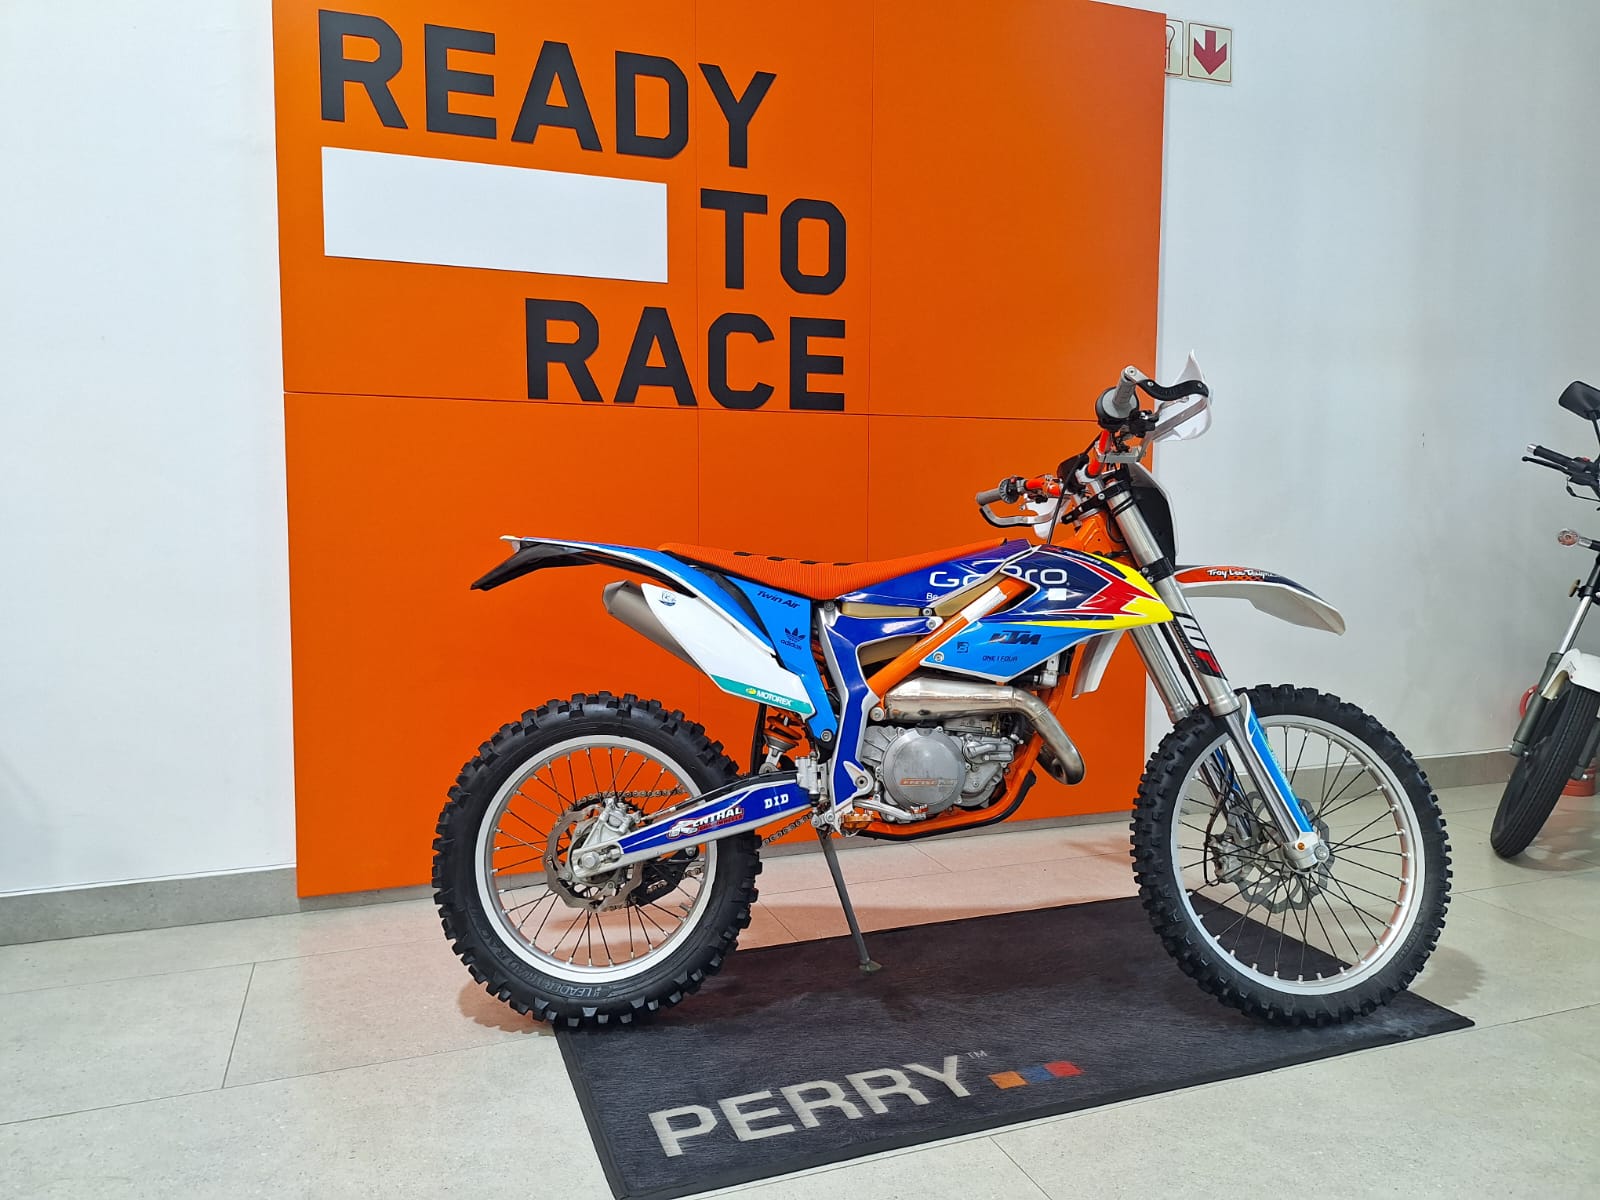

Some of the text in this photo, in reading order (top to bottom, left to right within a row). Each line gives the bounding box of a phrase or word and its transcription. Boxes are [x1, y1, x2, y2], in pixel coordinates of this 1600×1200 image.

[318, 9, 777, 169] READY
[700, 188, 847, 295] TO
[525, 297, 846, 410] RACE
[757, 590, 801, 609] Twin Air
[780, 638, 803, 651] adidas
[987, 630, 1042, 645] KTM
[756, 690, 793, 707] MOTOREX
[648, 1049, 988, 1157] PERRY TM
